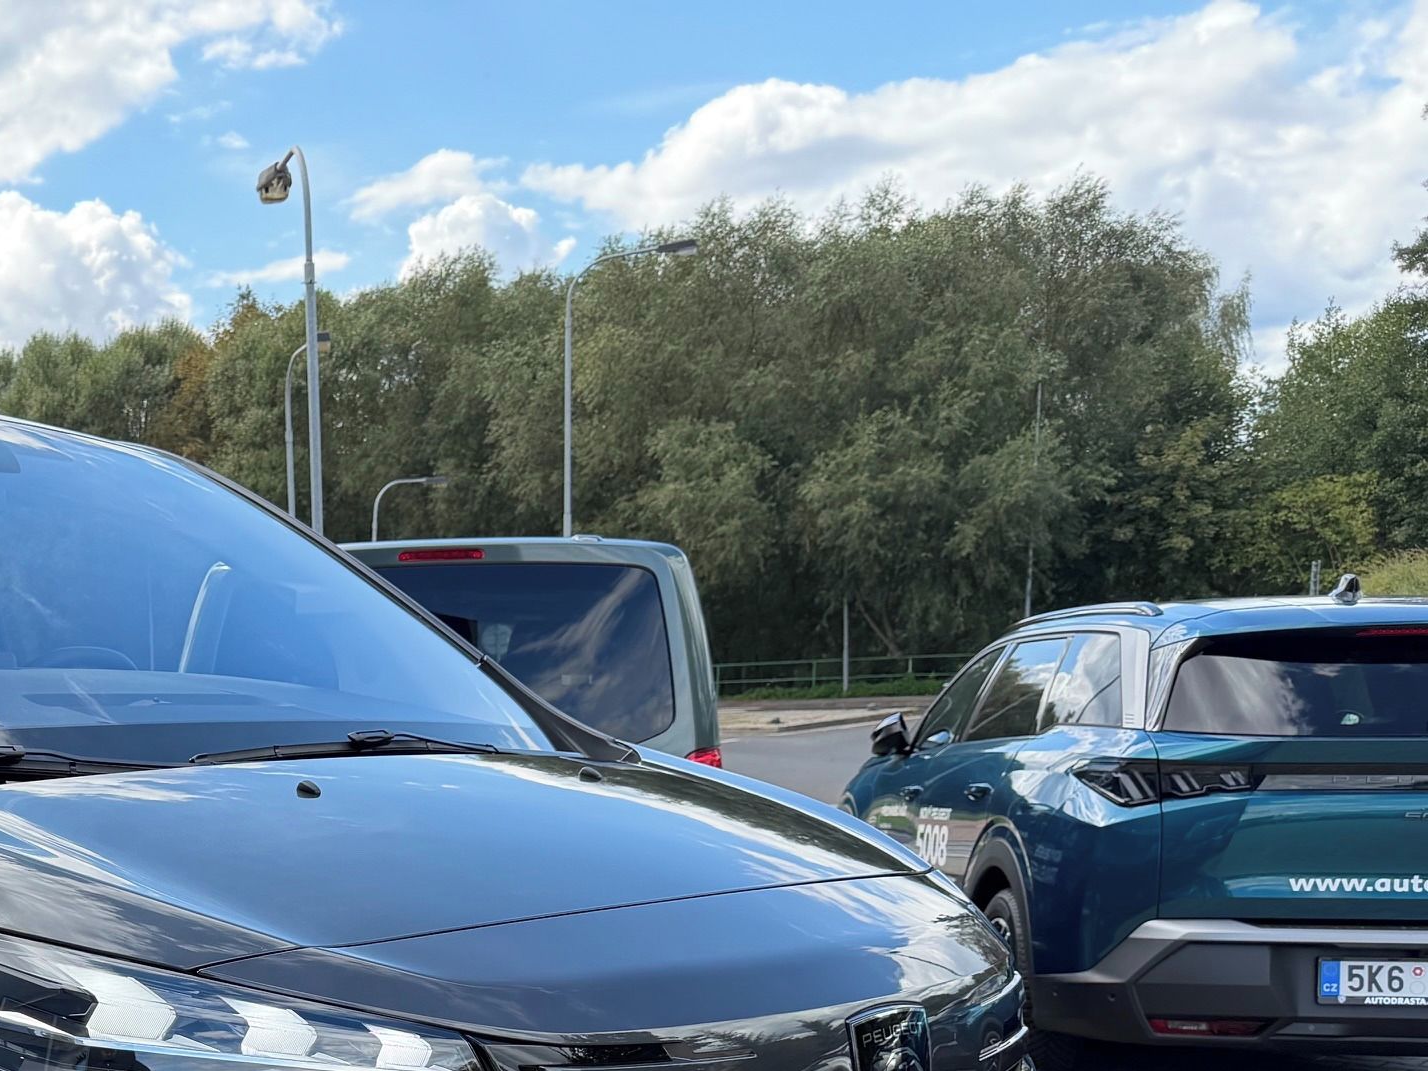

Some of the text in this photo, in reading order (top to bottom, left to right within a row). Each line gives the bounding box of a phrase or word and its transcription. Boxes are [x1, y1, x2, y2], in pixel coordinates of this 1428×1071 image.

[916, 824, 948, 866] 5008
[1289, 875, 1428, 892] www.aut
[1323, 983, 1338, 992] CZ
[1347, 965, 1404, 993] 5K6
[862, 1021, 923, 1047] PEUGEOT
